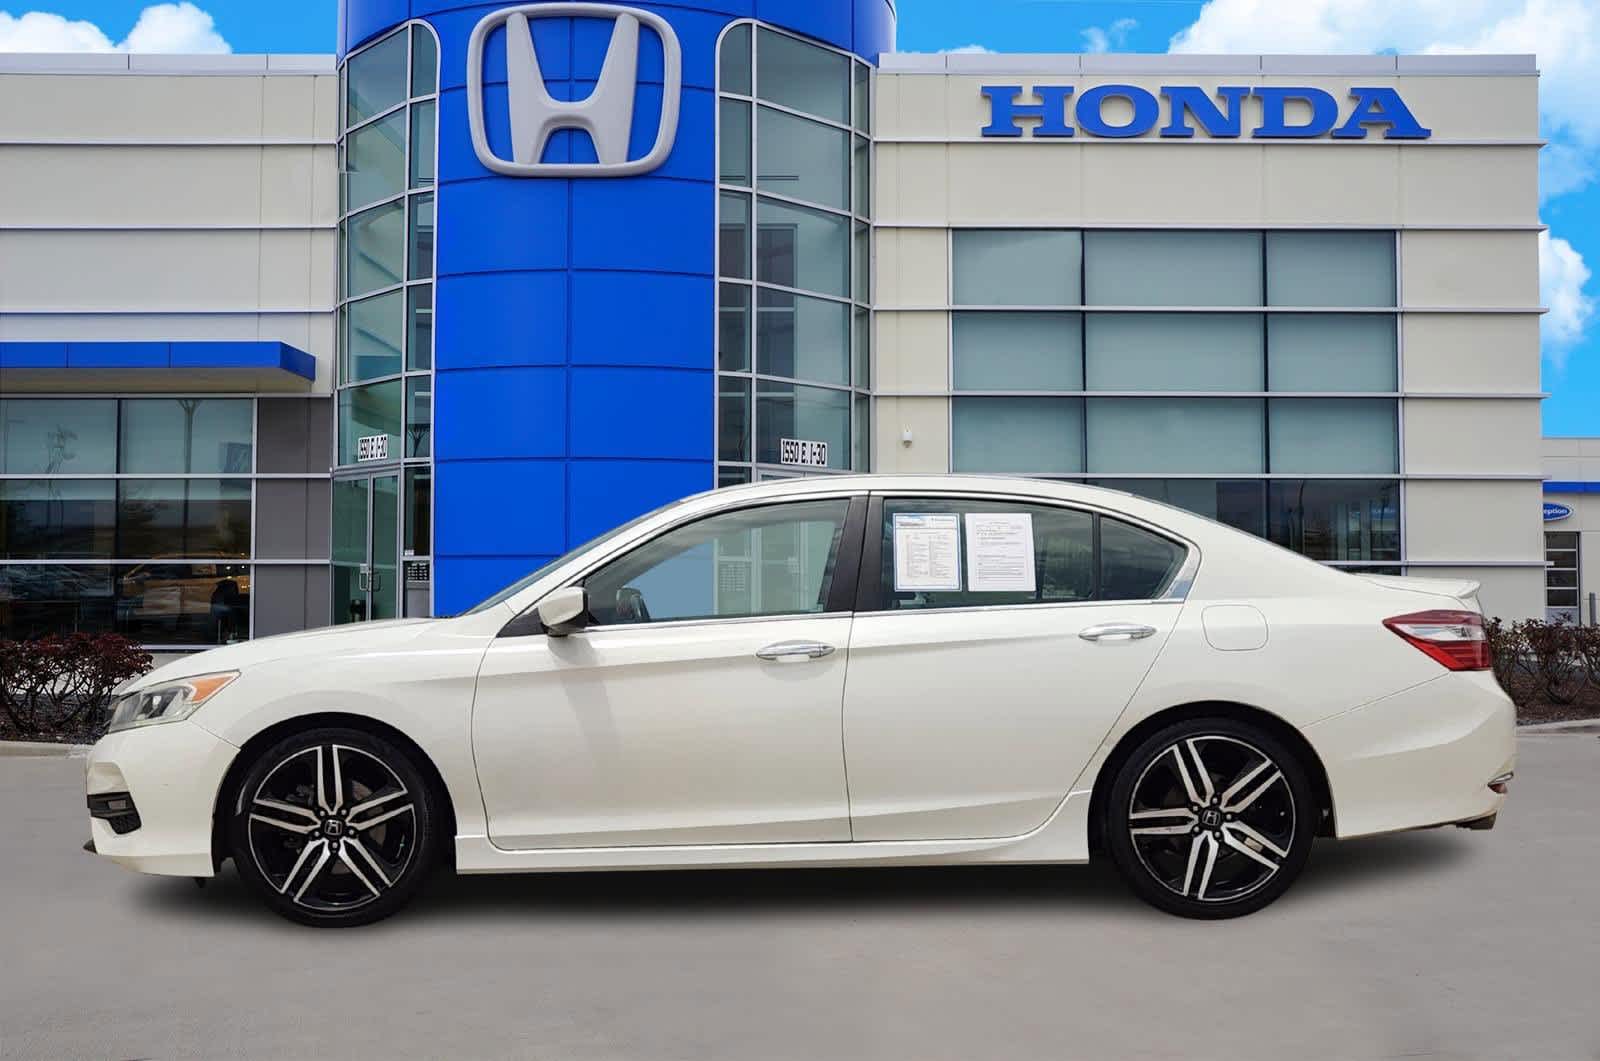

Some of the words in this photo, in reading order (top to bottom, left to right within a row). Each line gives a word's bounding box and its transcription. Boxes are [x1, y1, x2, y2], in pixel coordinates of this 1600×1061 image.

[980, 84, 1432, 140] HONDA
[782, 440, 800, 463] 1550
[810, 443, 826, 465] I-30
